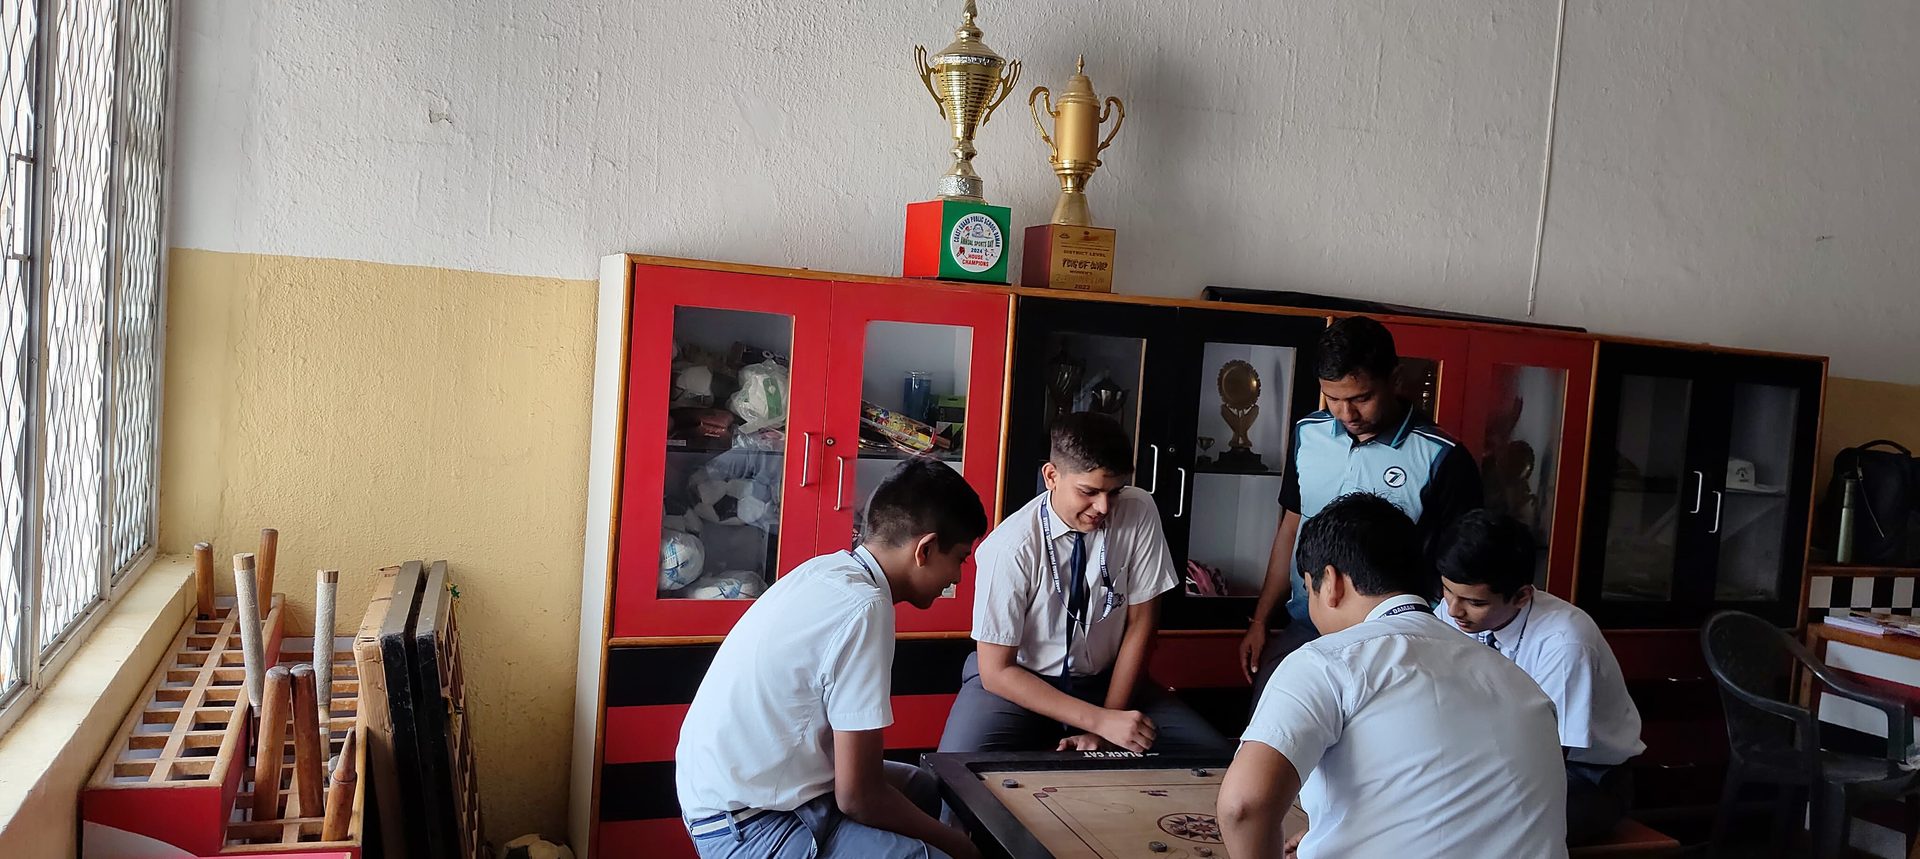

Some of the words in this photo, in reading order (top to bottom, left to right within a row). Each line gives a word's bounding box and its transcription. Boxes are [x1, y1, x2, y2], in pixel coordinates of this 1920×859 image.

[970, 215, 984, 223] PUBLIC
[962, 259, 989, 267] CHAMPIONS
[1392, 604, 1416, 614] DAMAN
